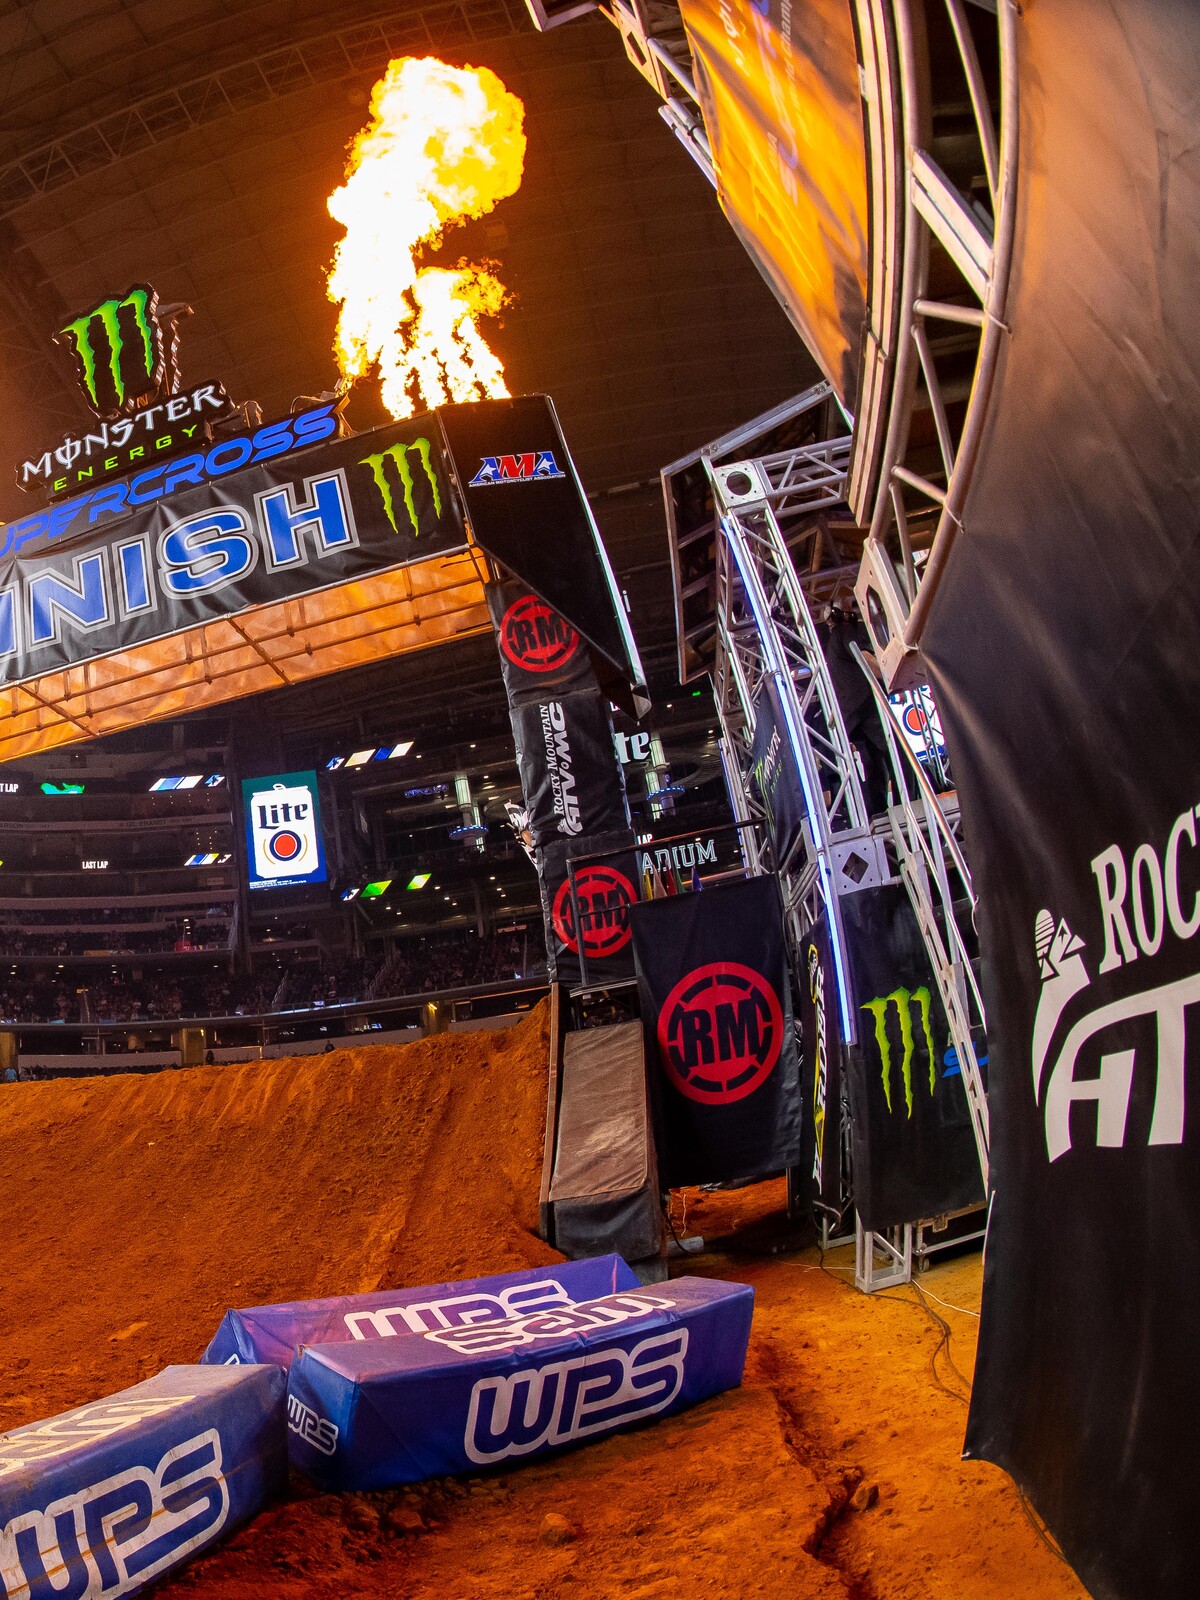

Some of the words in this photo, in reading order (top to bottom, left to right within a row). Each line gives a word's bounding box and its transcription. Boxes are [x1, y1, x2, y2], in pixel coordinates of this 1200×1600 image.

[22, 384, 224, 482] MONSTER
[54, 424, 197, 491] ENERGY
[468, 450, 564, 484] AMA
[539, 704, 558, 771] MOUNTAIN
[613, 731, 650, 764] te
[5, 783, 19, 793] LAP
[551, 776, 565, 815] ROCKY
[257, 803, 308, 830] Lite
[81, 860, 97, 869] LAST
[97, 861, 109, 869] LAP
[642, 839, 717, 875] ADIUM
[465, 1327, 689, 1465] WPS
[287, 1393, 339, 1456] WPS
